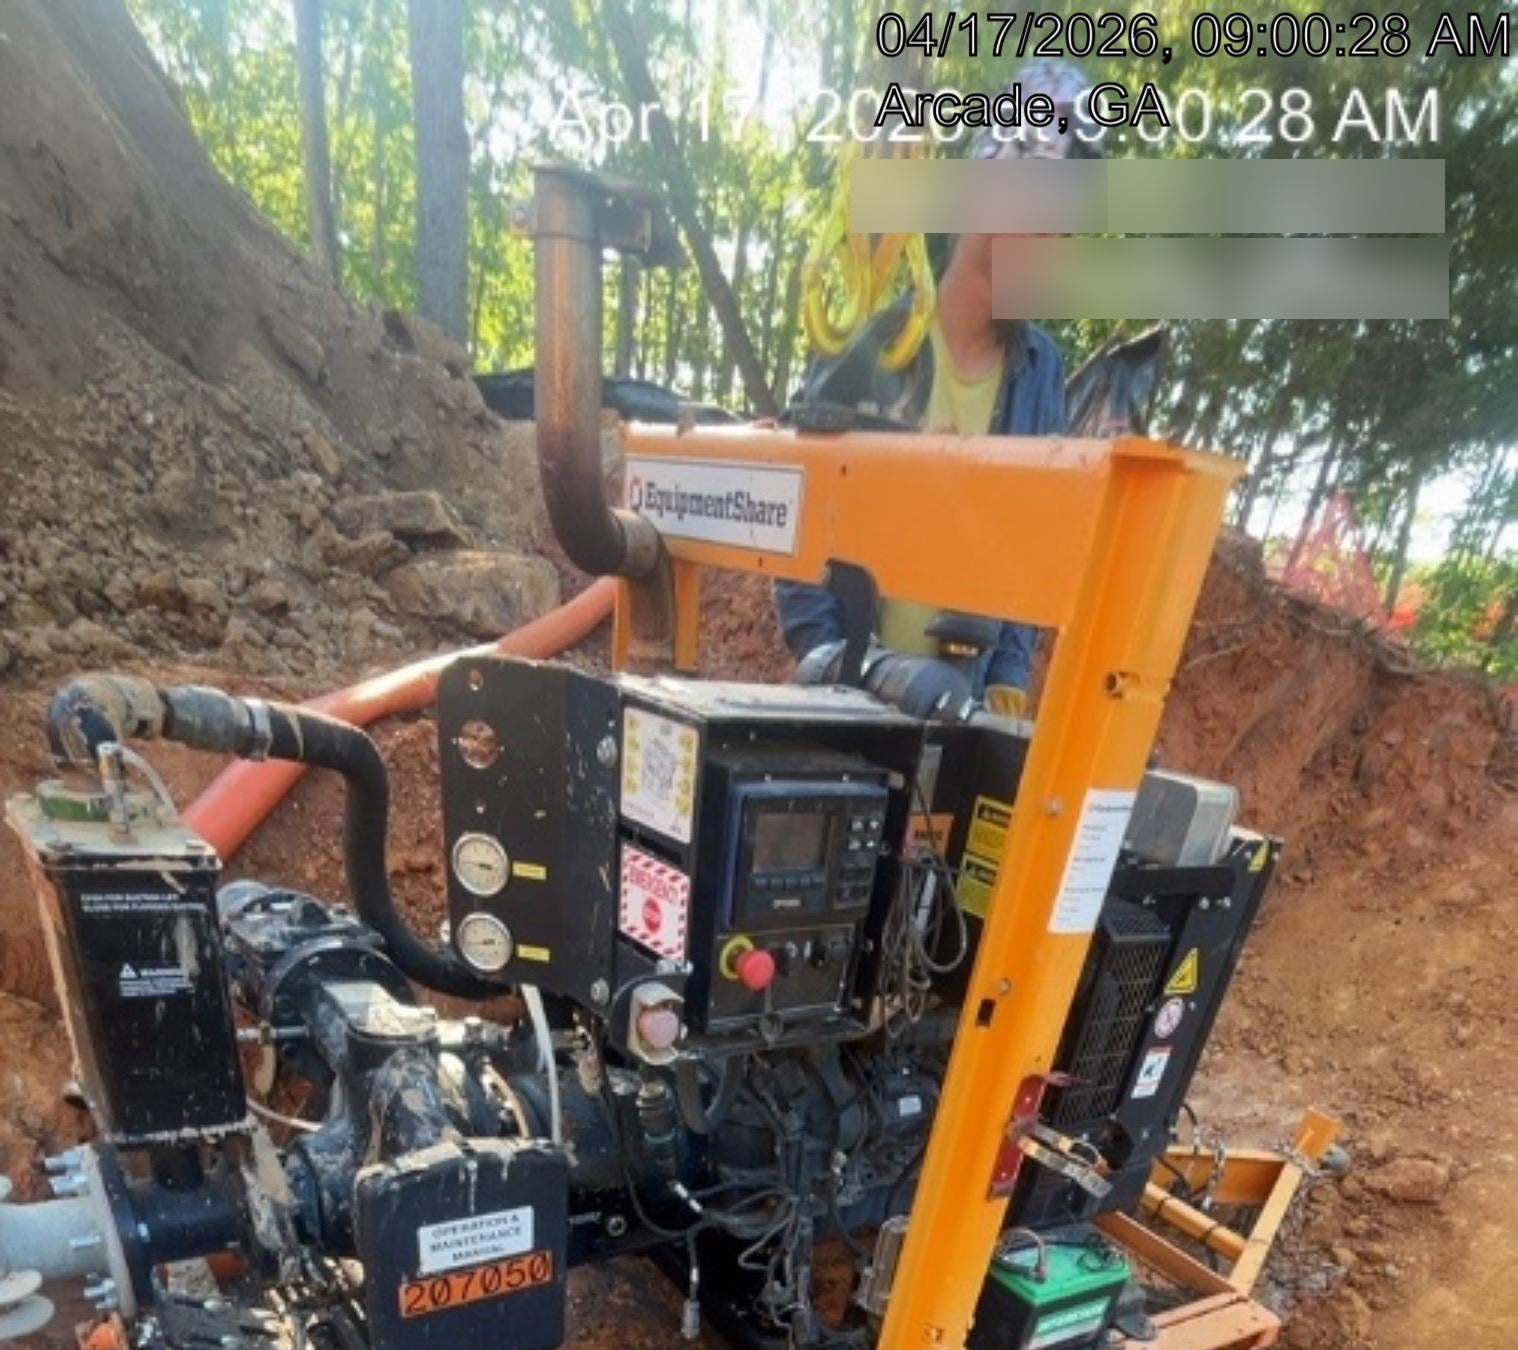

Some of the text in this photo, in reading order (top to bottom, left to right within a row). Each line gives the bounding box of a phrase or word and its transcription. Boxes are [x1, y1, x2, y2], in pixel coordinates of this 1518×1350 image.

[645, 482, 788, 528] EquipmentShare
[431, 1215, 508, 1239] OPERATION
[404, 1254, 548, 1314] 207050
